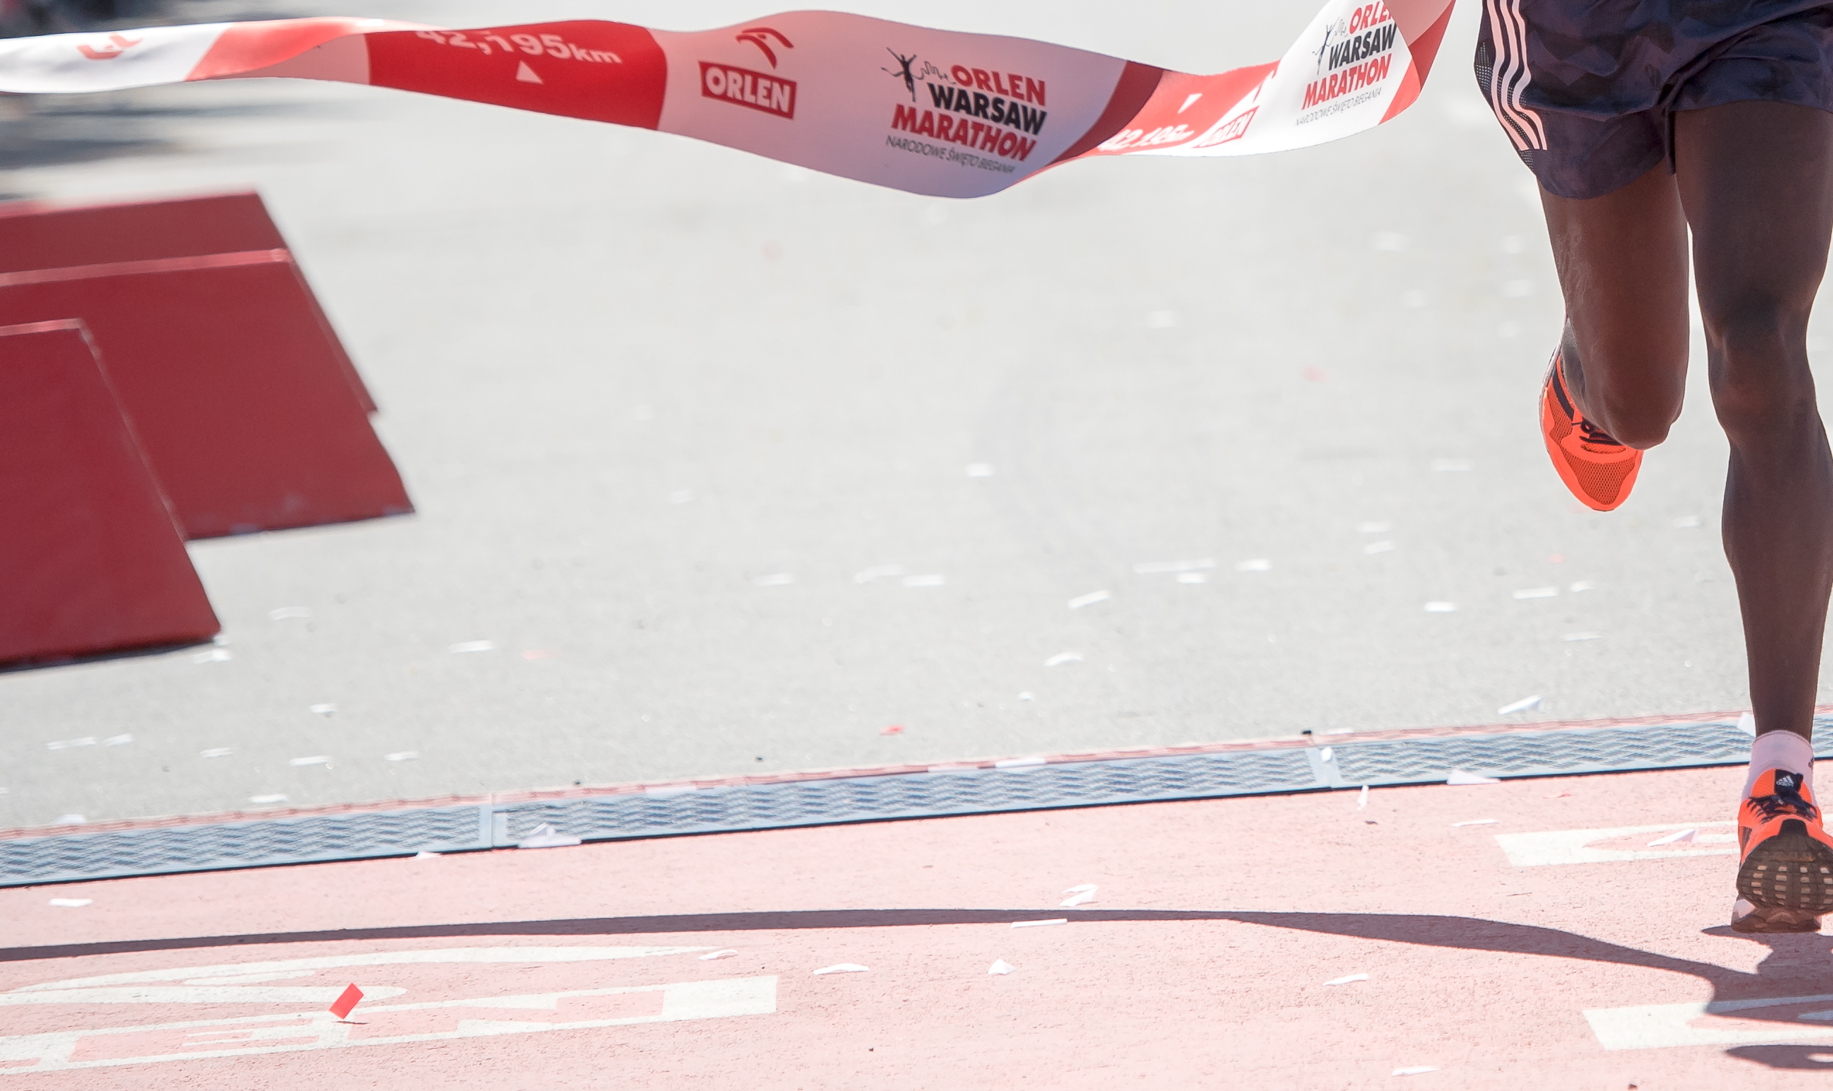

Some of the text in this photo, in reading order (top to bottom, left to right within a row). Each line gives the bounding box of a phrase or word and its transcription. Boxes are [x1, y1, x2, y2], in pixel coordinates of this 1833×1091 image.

[416, 30, 622, 64] 42,195km
[1328, 23, 1397, 71] WARSAW
[705, 66, 791, 113] ORLEN
[951, 64, 1045, 107] ORLEN
[1301, 53, 1392, 110] MARATHON
[891, 103, 1037, 161] MARATHON
[927, 82, 1048, 136] WARSAW
[886, 135, 946, 159] NARODOWE
[948, 146, 980, 167] ŚWIĘTO
